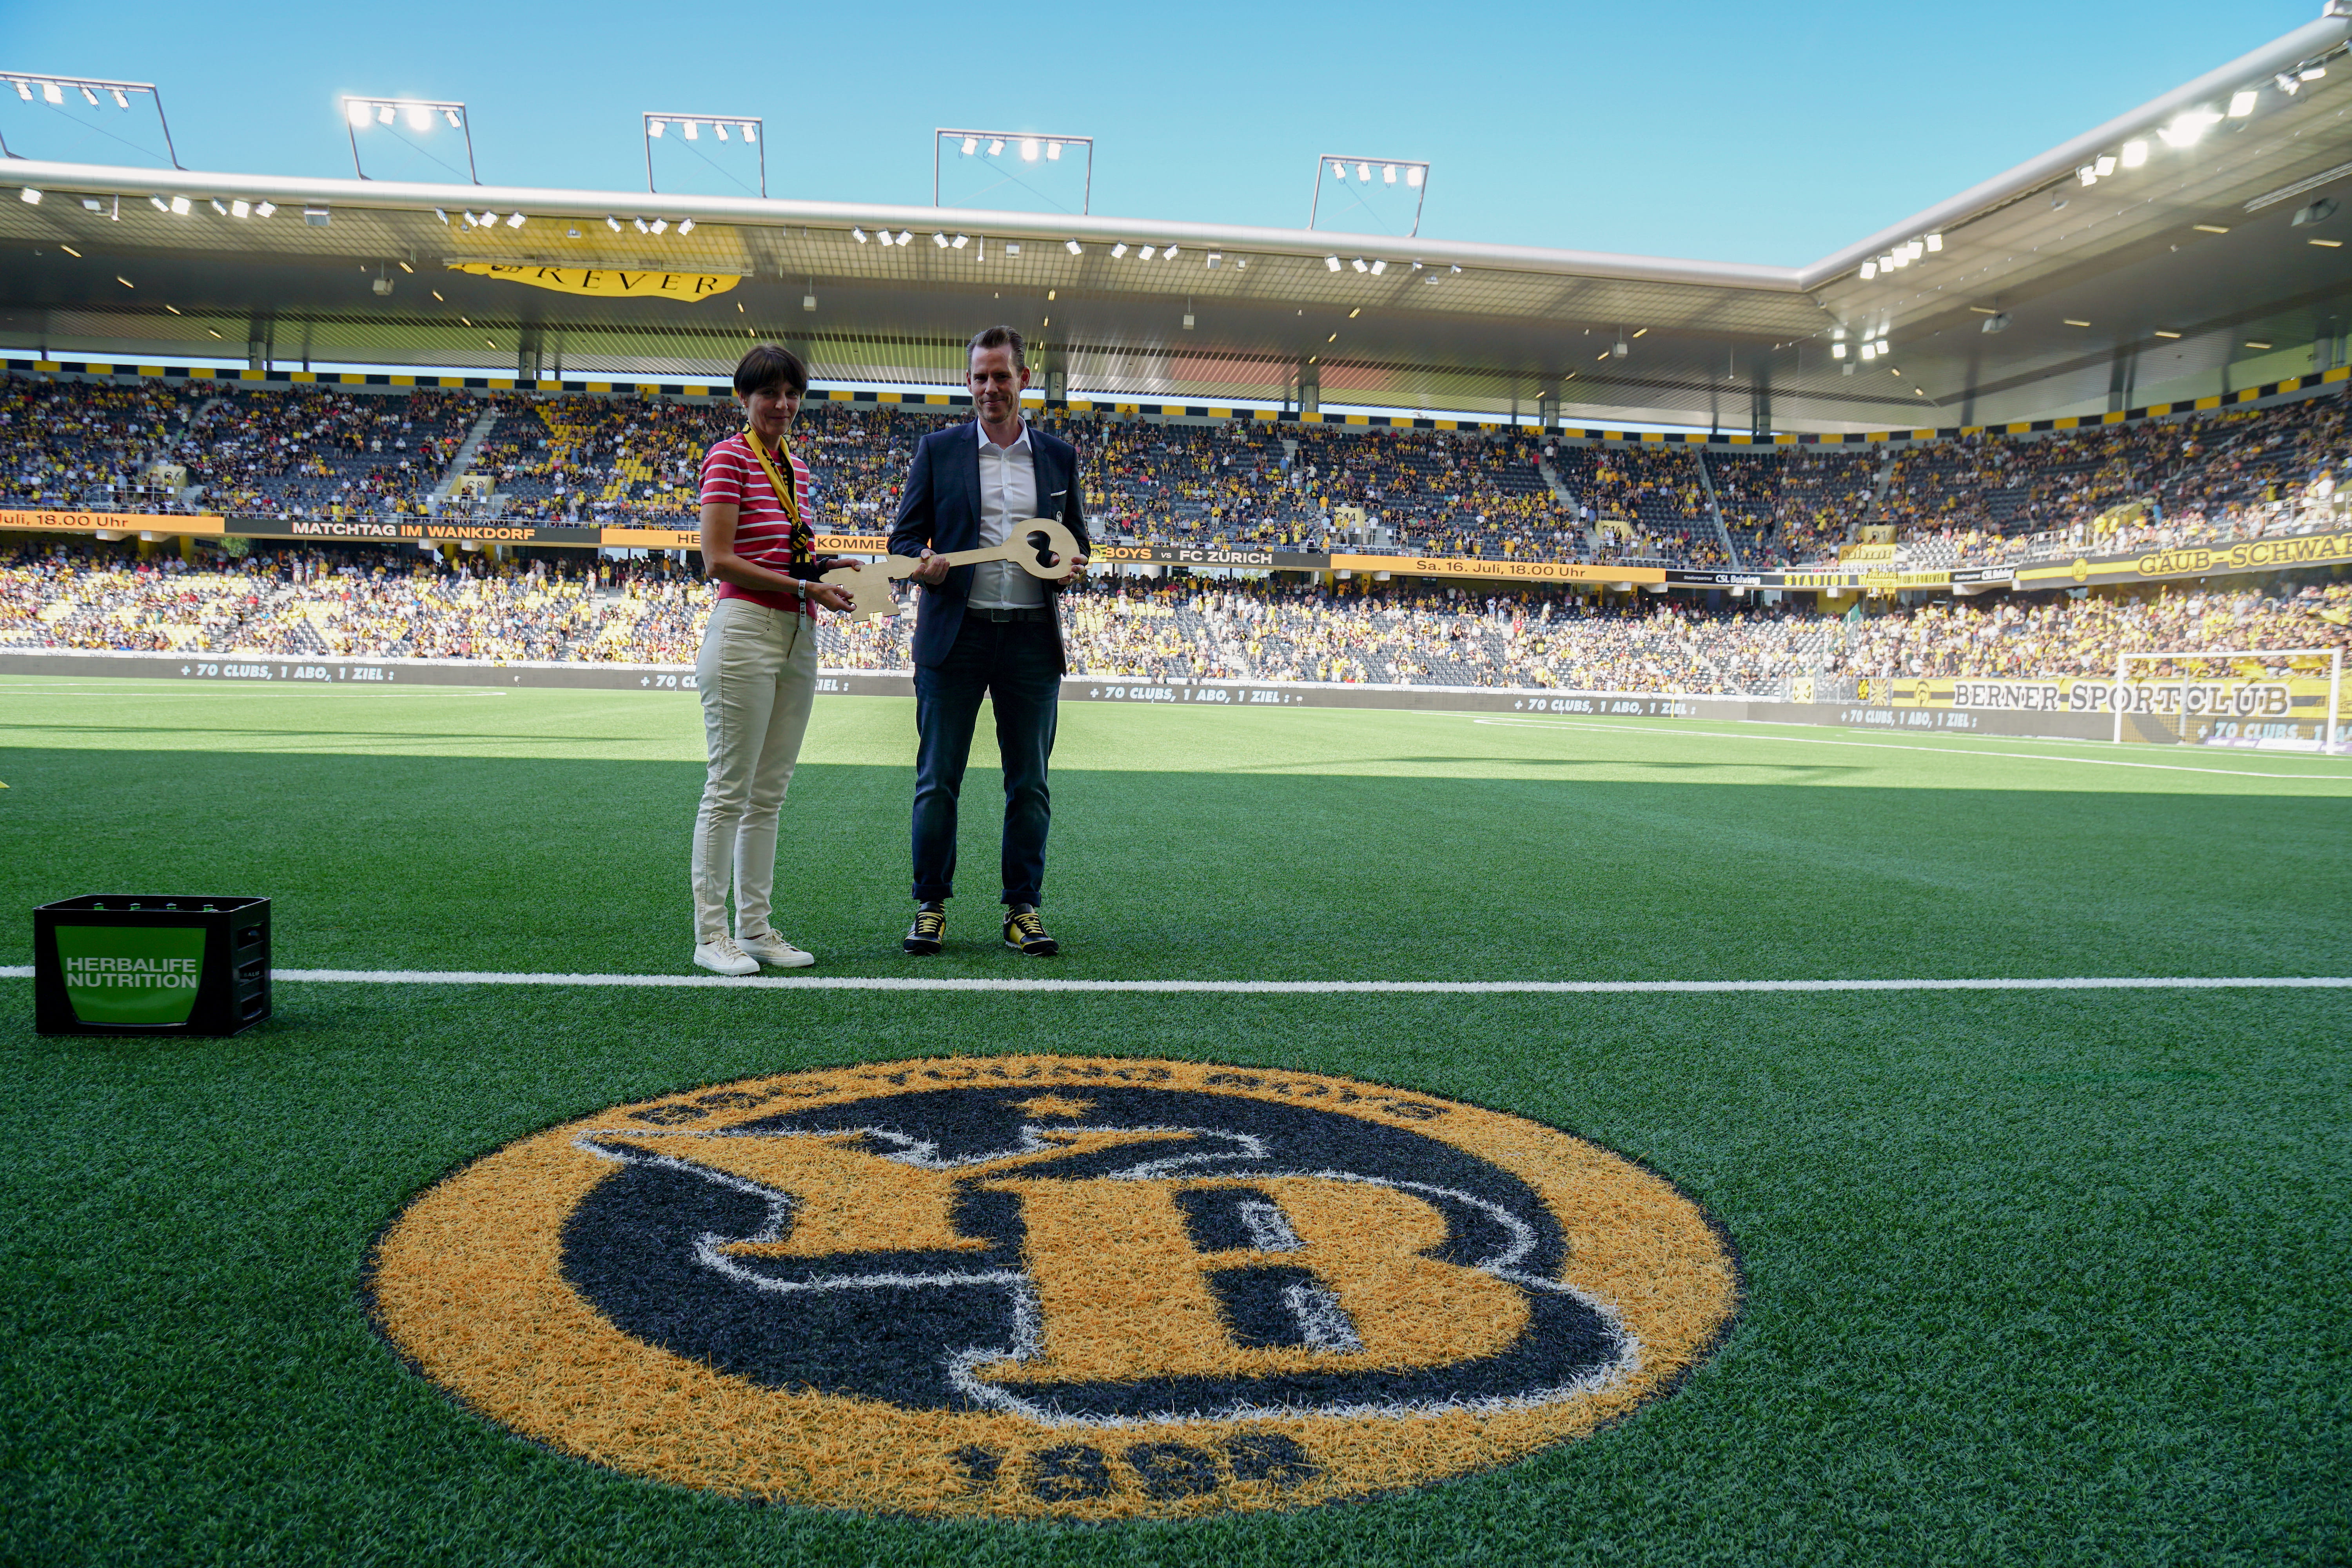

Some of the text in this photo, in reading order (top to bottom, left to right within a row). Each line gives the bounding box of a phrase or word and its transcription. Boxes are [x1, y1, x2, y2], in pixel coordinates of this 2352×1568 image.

[537, 267, 718, 294] REVER
[37, 515, 89, 526] 18.00
[97, 517, 128, 527] Uhr
[292, 522, 535, 540] MATCHTAG IM WANKDORF
[678, 534, 886, 549] HE KOMME
[1106, 547, 1152, 559] BOYS
[1180, 550, 1203, 562] FC
[1208, 549, 1272, 564] ZÜRICH
[2140, 549, 2209, 573] GÄUB
[1417, 561, 1586, 577] Sa. 16. Juli, 18.00 Uhr
[1716, 574, 1730, 584] CSL
[1730, 574, 1760, 586] Behring
[1784, 574, 1849, 586] STADION
[196, 663, 218, 676] 70
[223, 664, 272, 680] CLUBS,
[281, 666, 288, 678] 1
[294, 666, 331, 681] ABO,
[339, 667, 346, 679] 1
[352, 668, 383, 680] ZIEL
[656, 675, 677, 687] 70
[682, 675, 697, 688] CL
[815, 679, 838, 691] IEL
[1104, 686, 1125, 699] 70
[1130, 687, 1176, 702] CLUBS,
[1183, 689, 1190, 701] 1
[1196, 689, 1231, 704] ABO,
[1238, 690, 1245, 702] 1
[1250, 691, 1279, 703] ZIEL
[1955, 684, 2290, 715] BERNER SPORTCLUB
[1528, 698, 1547, 710] 70
[1551, 699, 1593, 714] CLUBS,
[1600, 701, 1607, 712] 1
[1612, 701, 1643, 715] ABO,
[1650, 702, 1656, 713] 1
[1850, 709, 1863, 722] 70
[1865, 710, 1895, 726] CLUBS,
[1900, 711, 1904, 725] 1
[1908, 711, 1933, 728] ABO,
[1938, 713, 1943, 726] 1
[1946, 713, 1969, 728] ZIEL
[2215, 722, 2238, 738] 70
[2314, 724, 2324, 741] 1
[67, 957, 196, 973] HERBALIFE
[67, 973, 196, 988] NUTRITION
